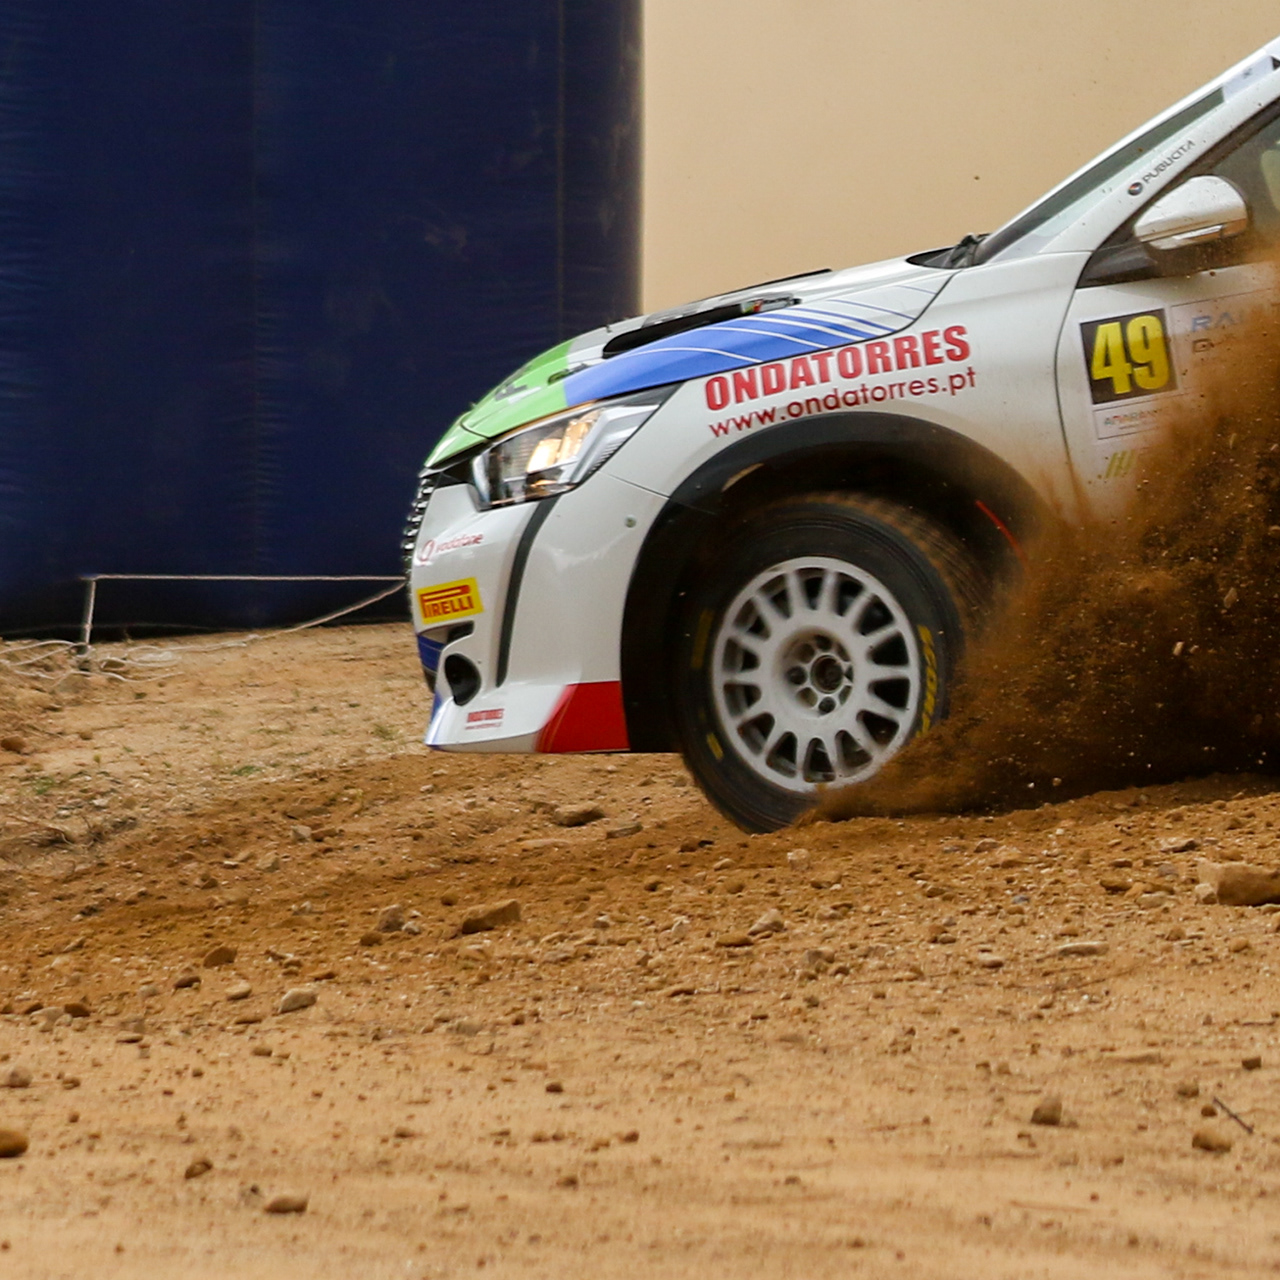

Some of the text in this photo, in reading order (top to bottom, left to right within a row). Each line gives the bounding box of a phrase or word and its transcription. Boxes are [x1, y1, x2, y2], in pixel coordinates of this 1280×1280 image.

[704, 324, 971, 411] ONDATORRES
[1090, 314, 1171, 395] 49
[708, 366, 977, 438] www.ondatorres.pt
[420, 584, 475, 618] PIRELLI
